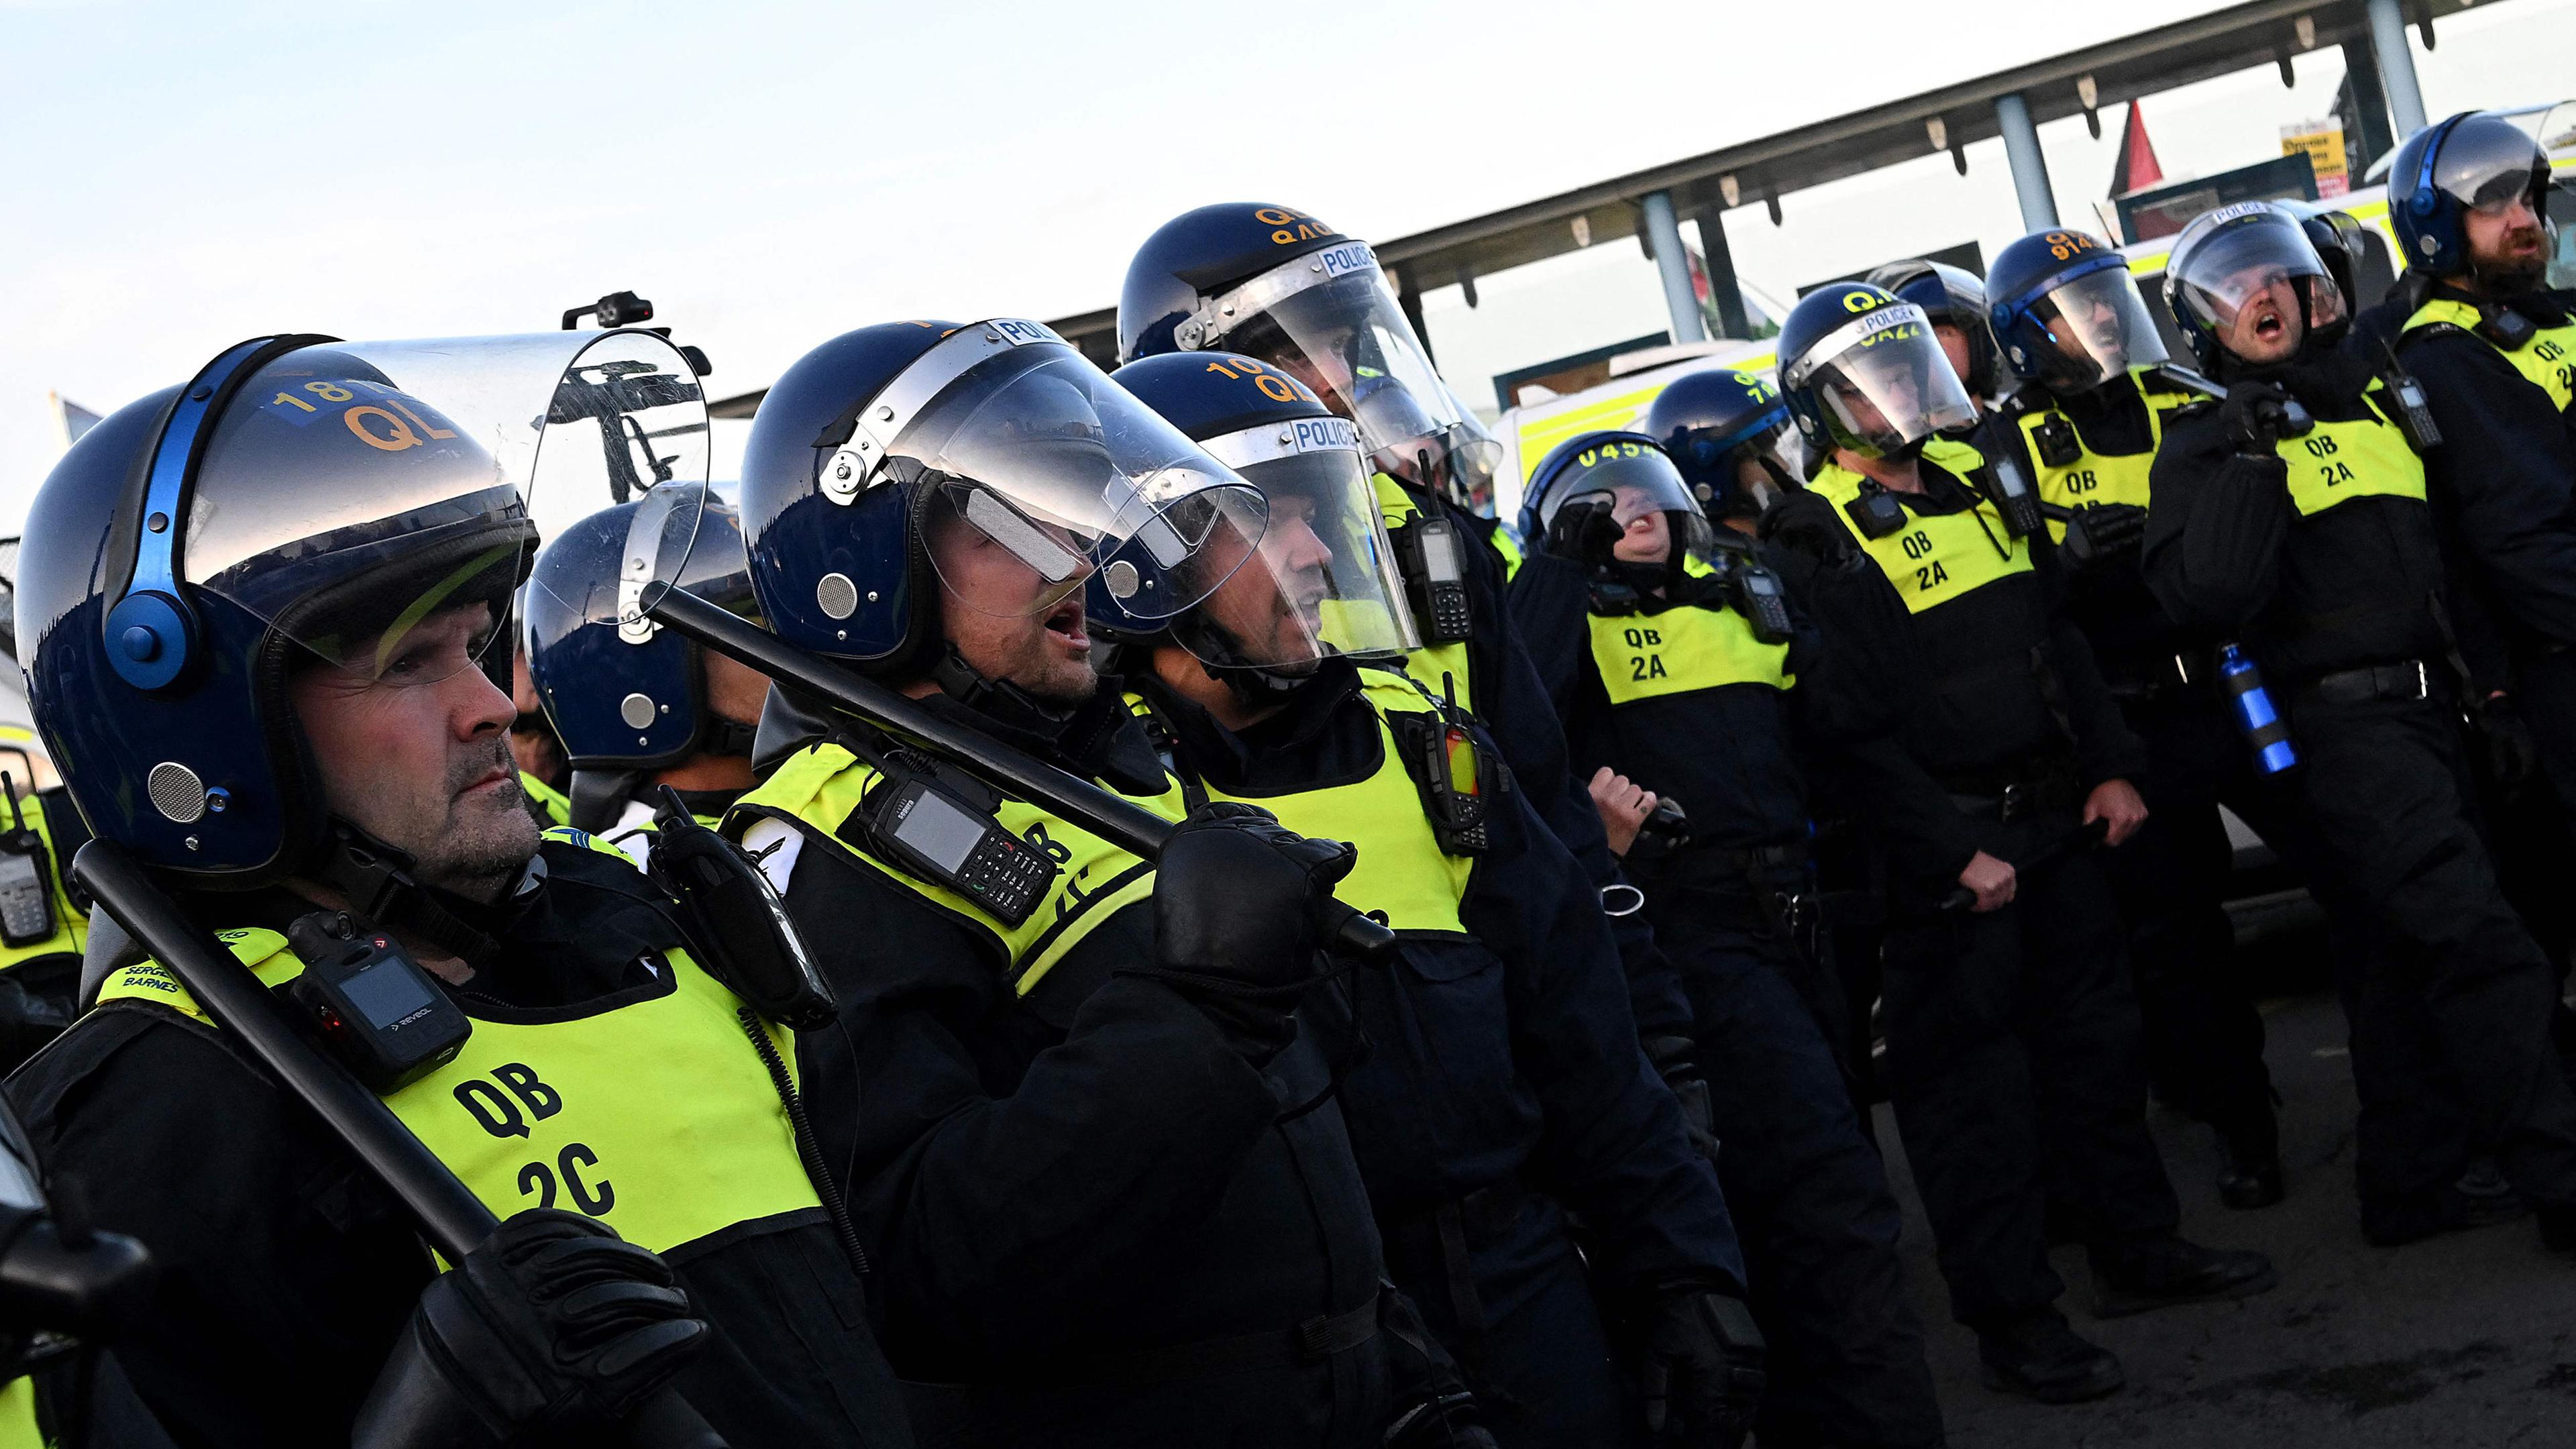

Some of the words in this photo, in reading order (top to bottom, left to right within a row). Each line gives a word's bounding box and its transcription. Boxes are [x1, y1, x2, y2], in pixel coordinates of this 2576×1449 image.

[1866, 308, 1910, 331] POLICE
[2534, 339, 2564, 361] QB
[1254, 374, 1316, 402] QL
[343, 399, 458, 451] QL
[1295, 422, 1356, 448] POLICE
[2304, 435, 2338, 460] QB
[2066, 470, 2097, 495] QB
[2320, 462, 2355, 488] 2A
[1902, 531, 1933, 559] QB
[1917, 559, 1948, 592] 2A
[1624, 628, 1662, 649] QB
[1630, 654, 1667, 682] 2A
[897, 799, 914, 820] sepura
[123, 977, 178, 993] BARNES
[452, 1063, 563, 1139] QB
[517, 1142, 615, 1217] 2C
